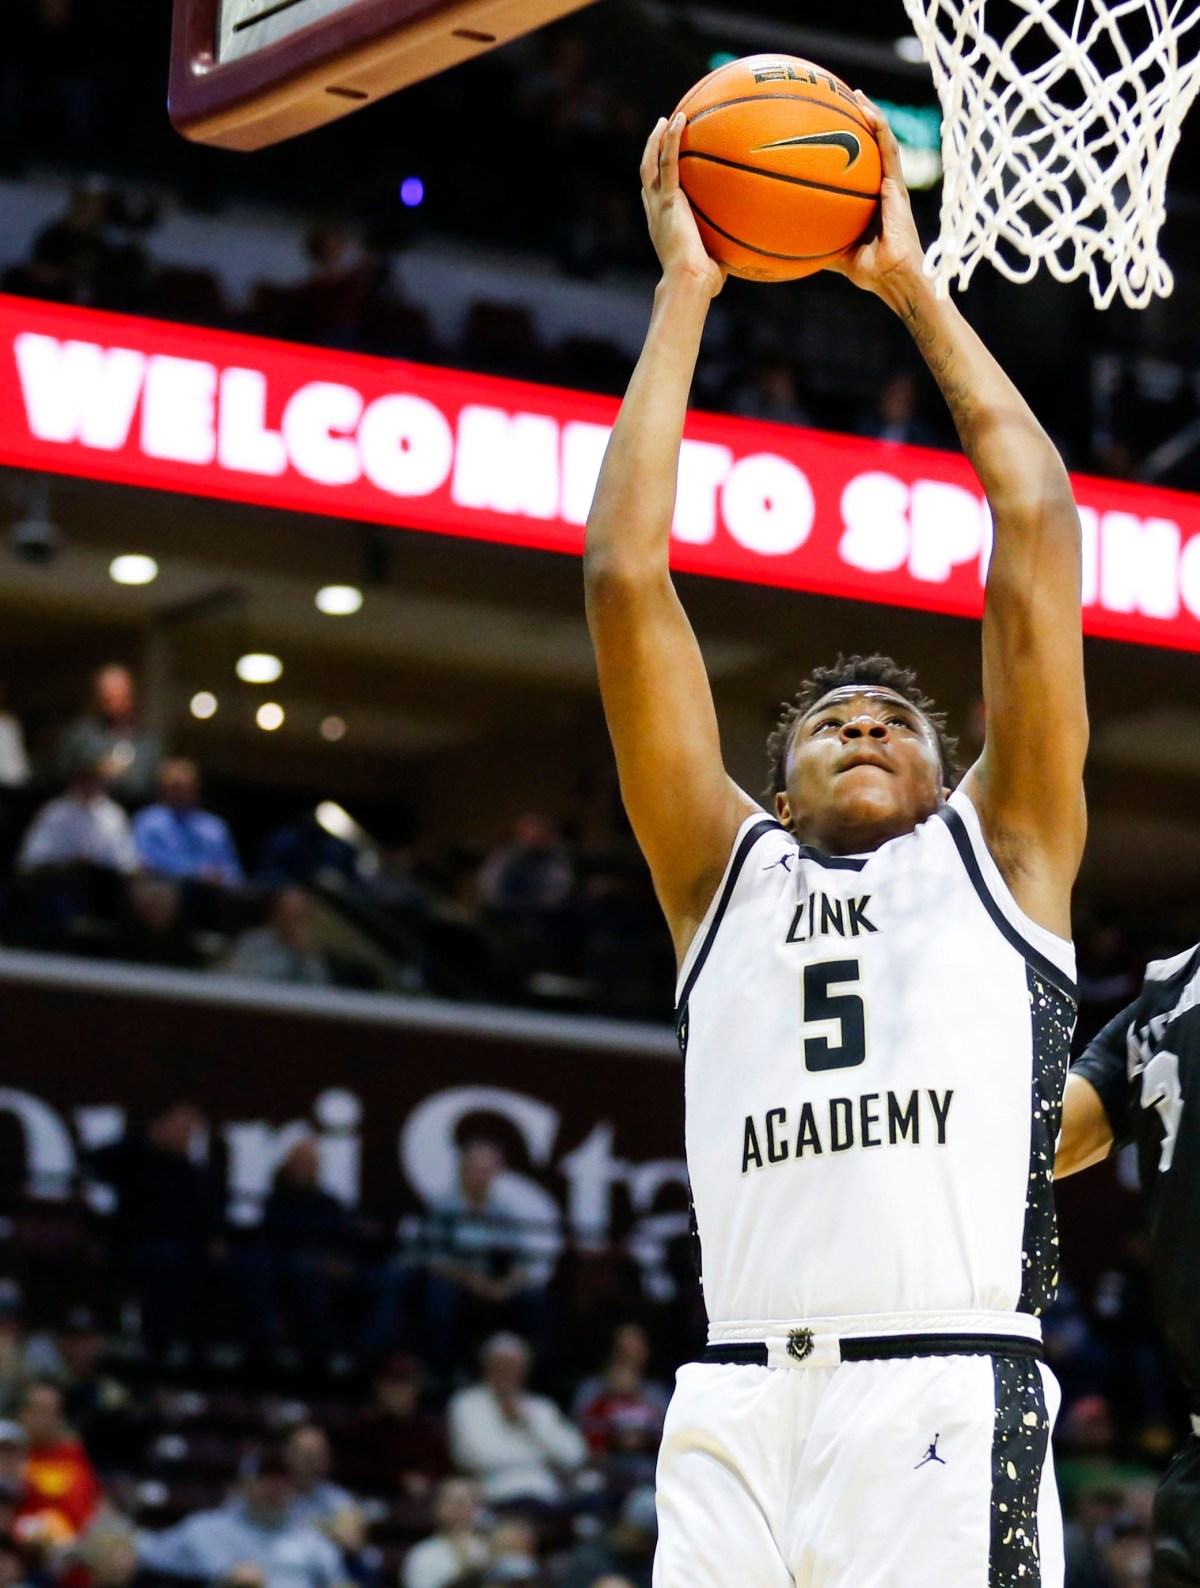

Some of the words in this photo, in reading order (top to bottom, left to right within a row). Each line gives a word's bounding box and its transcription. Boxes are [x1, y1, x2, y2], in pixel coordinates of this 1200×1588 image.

[750, 64, 859, 104] ELITE
[670, 438, 815, 556] TO
[783, 889, 882, 945] LINK
[801, 954, 868, 1076] 5
[740, 1087, 955, 1176] ACADEMY
